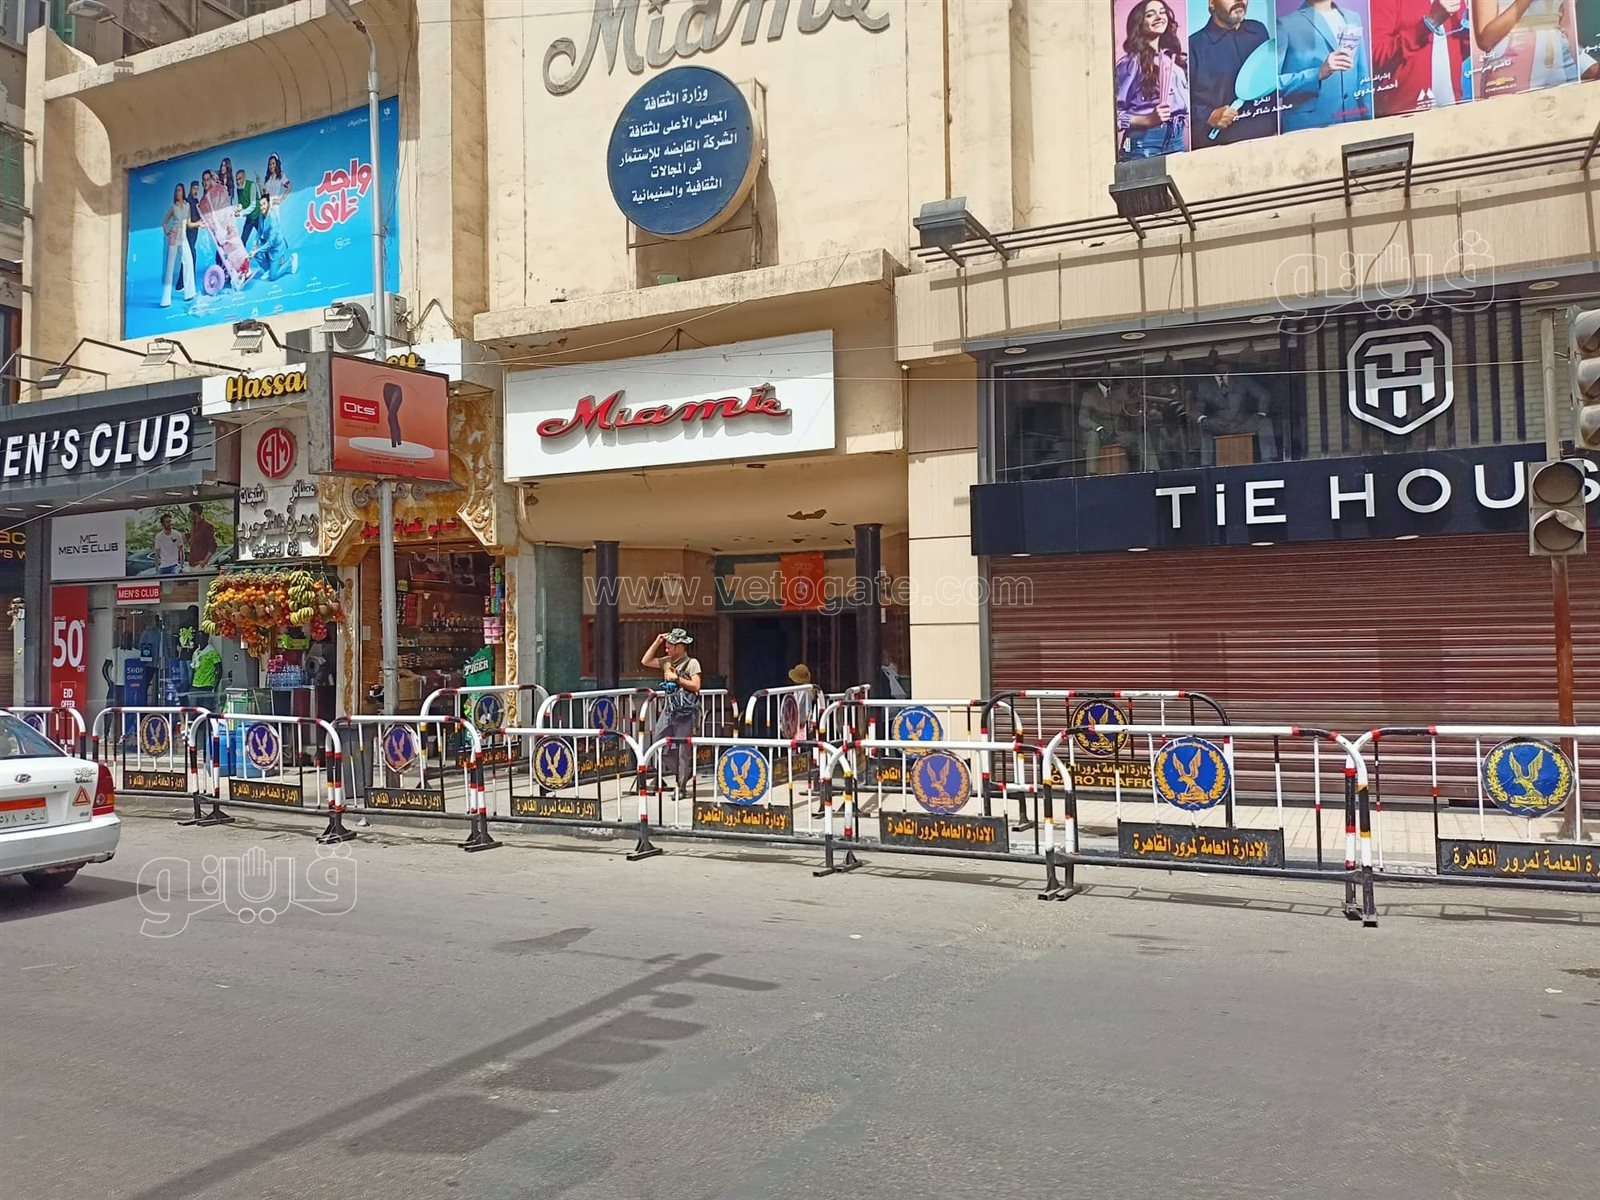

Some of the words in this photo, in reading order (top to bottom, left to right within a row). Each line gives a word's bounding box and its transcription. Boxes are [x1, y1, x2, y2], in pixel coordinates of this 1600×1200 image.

[644, 90, 679, 111] الثقافة
[682, 86, 708, 104] وزارة
[663, 115, 692, 135] الأعلى
[695, 109, 727, 129] المجلس
[628, 120, 660, 138] للثقافة
[703, 131, 737, 150] الشركة
[316, 158, 372, 197] واحد
[650, 162, 686, 178] المجالات
[685, 176, 722, 196] الثقافية
[226, 372, 307, 403] Hassa
[0, 428, 80, 477] EN'S
[89, 413, 191, 467] CLUB
[91, 543, 119, 553] CLUB
[118, 589, 140, 599] MEN'S
[140, 588, 159, 598] CLUB
[463, 660, 489, 677] TIGER
[696, 807, 723, 824] القاهرة
[724, 810, 740, 827] لمرور
[742, 810, 764, 825] العامة
[887, 816, 918, 837] القاهرة
[918, 821, 938, 840] لمرور
[940, 821, 964, 839] العامة
[1133, 832, 1171, 855] القاهرة
[1173, 837, 1197, 857] لمرور
[1200, 836, 1230, 855] العامة
[1453, 847, 1496, 870] القاهرة
[1501, 850, 1540, 872] لمرور
[1543, 849, 1580, 872] العامة
